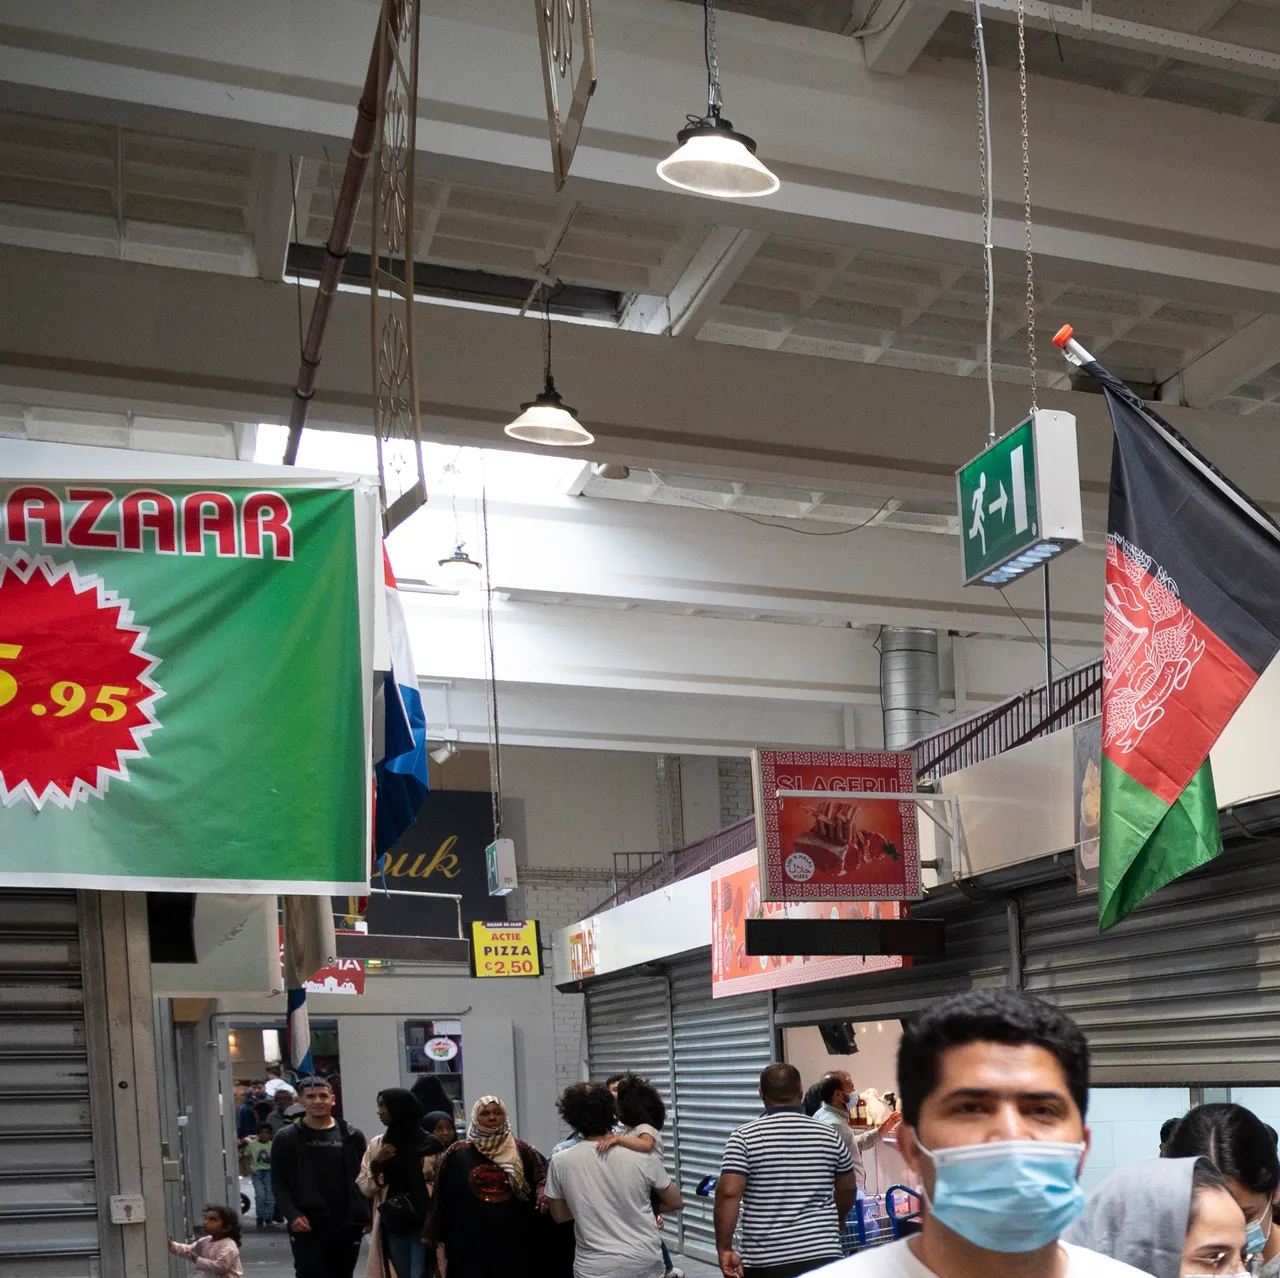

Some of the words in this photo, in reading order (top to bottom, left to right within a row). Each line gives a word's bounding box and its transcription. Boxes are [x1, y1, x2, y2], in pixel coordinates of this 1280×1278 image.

[4, 485, 294, 562] AZAAR
[491, 933, 521, 941] ACTIE
[483, 945, 532, 956] PIZZA
[484, 960, 533, 975] €2,50
